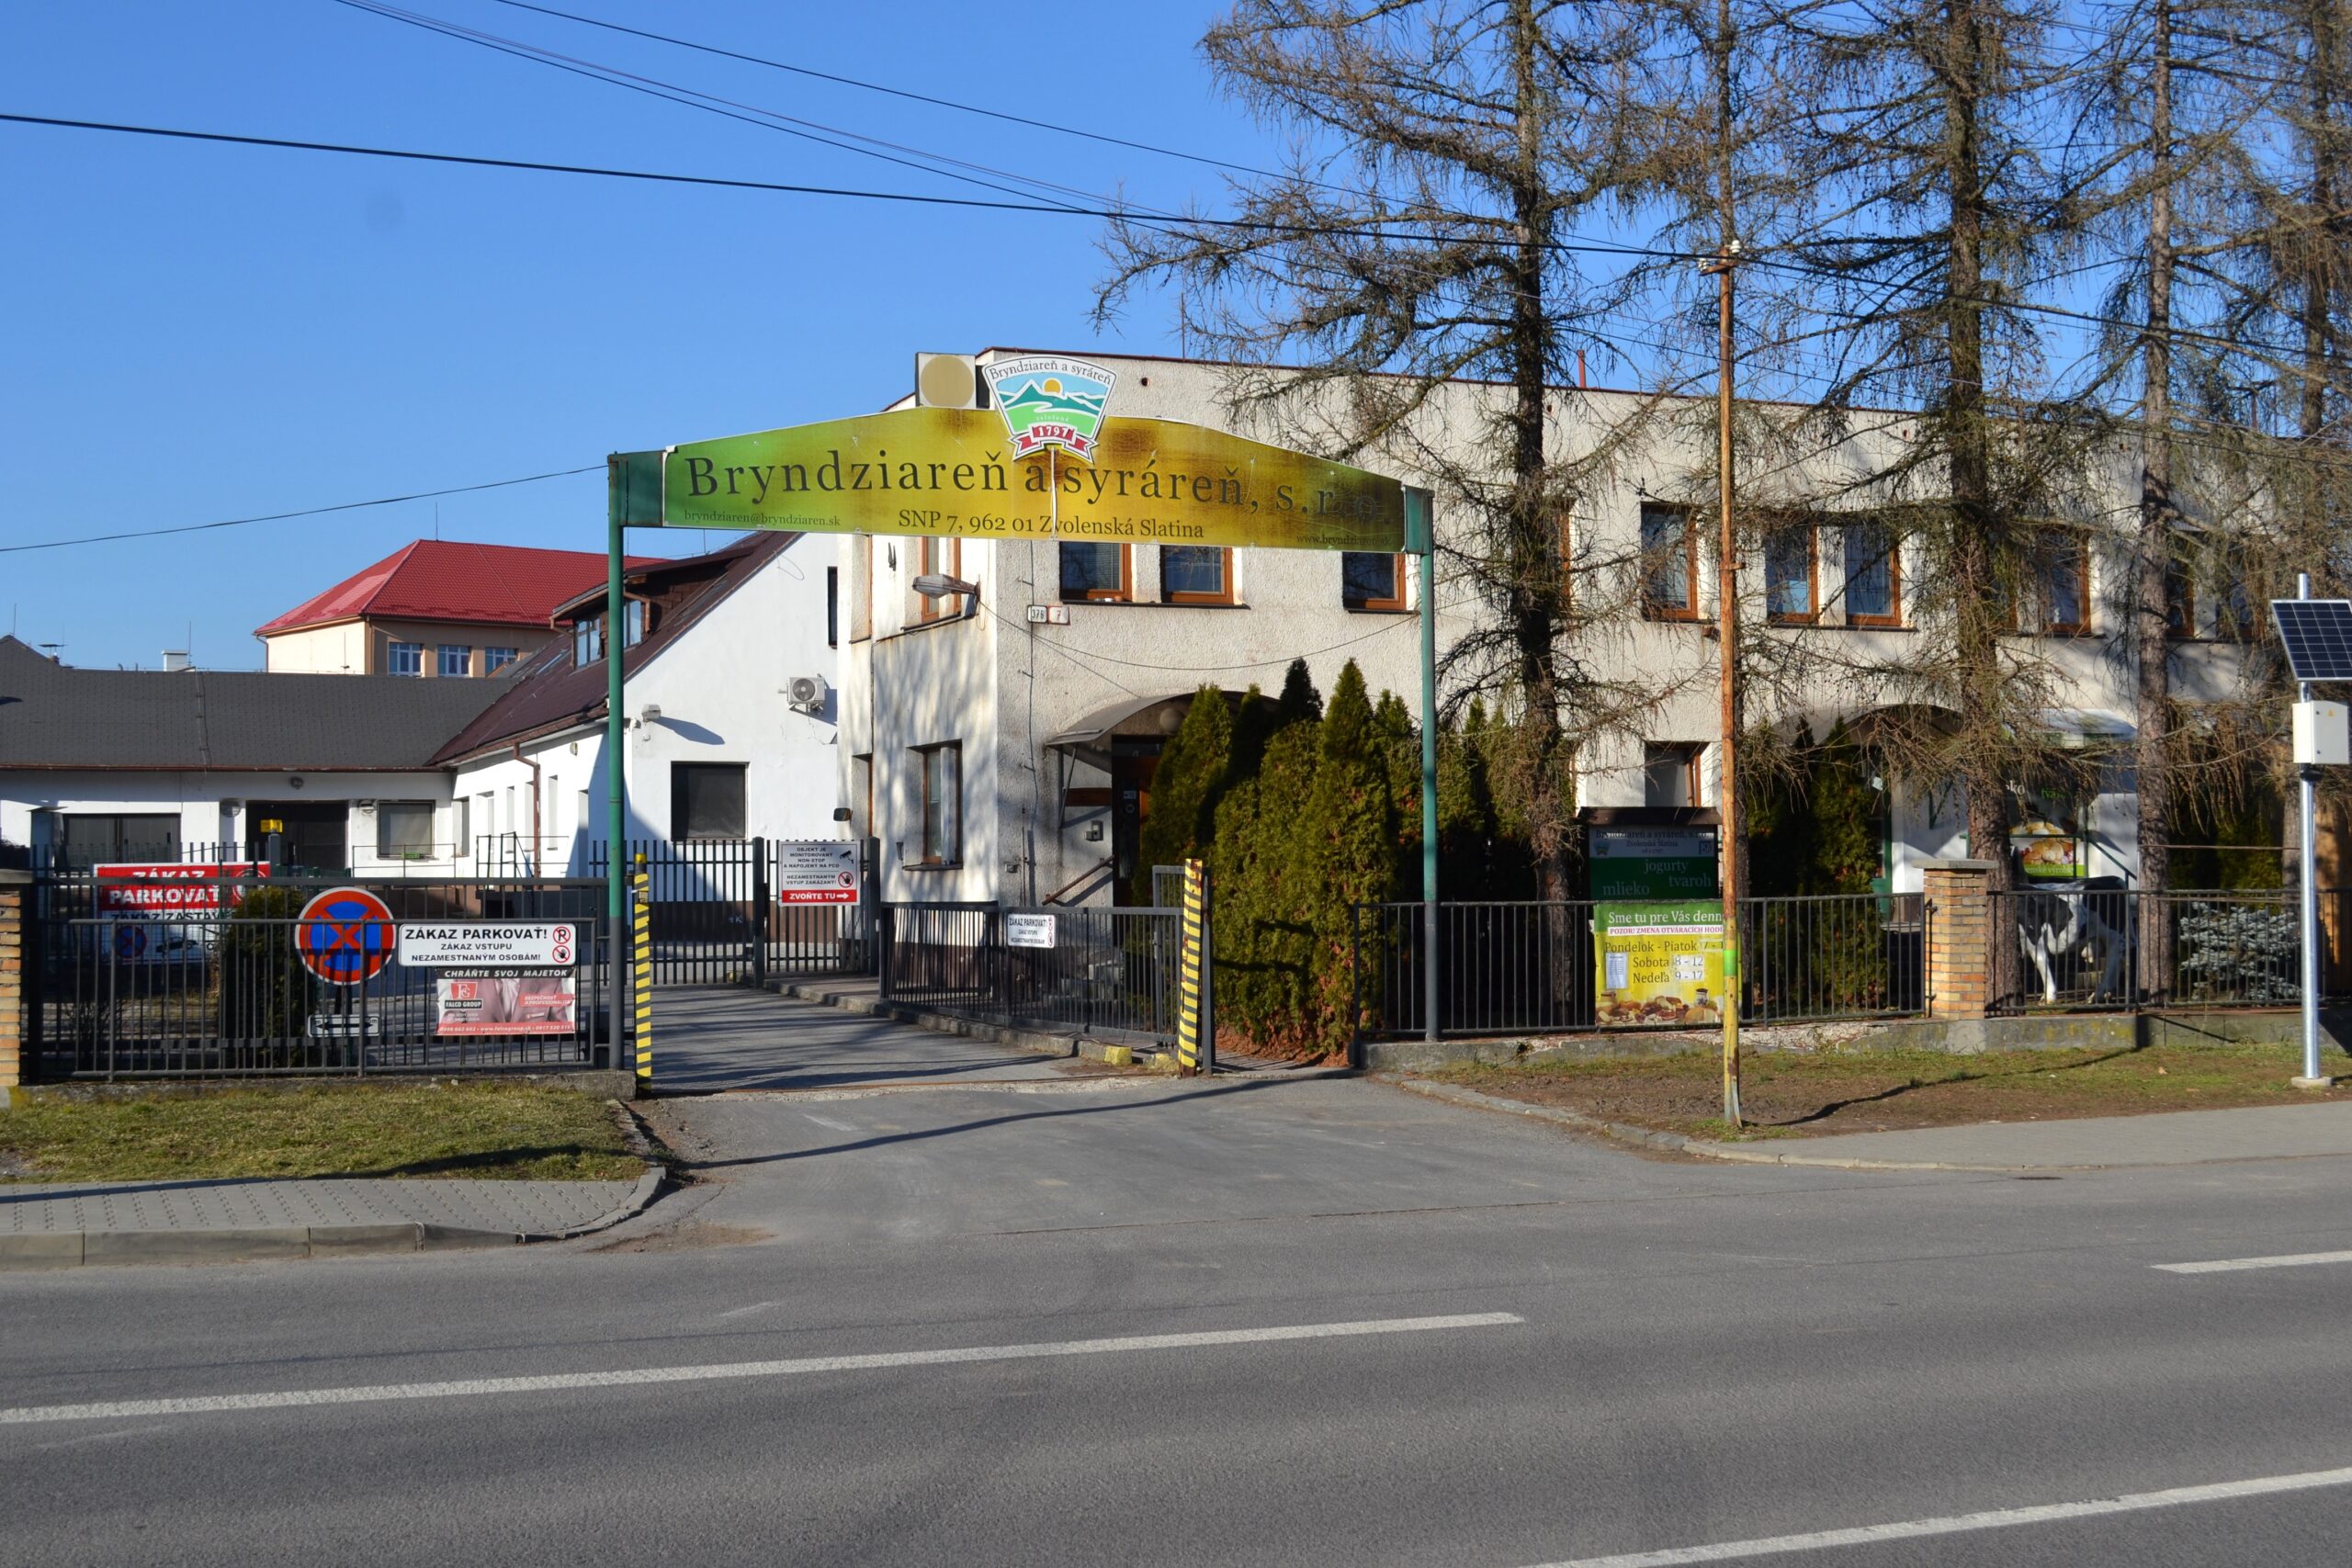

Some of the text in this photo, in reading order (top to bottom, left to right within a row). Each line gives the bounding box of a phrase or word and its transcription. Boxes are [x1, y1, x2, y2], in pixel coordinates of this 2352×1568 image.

[989, 360, 1112, 385] Bryndziareň a syráreň
[1037, 426, 1069, 438] 1797
[684, 450, 1009, 504] Bryndziareň
[1025, 462, 1046, 493] a
[1063, 459, 1259, 515] syráreň,
[684, 509, 841, 526] bryndziaren@bryndziaren.sk
[899, 510, 1204, 538] SNP 7, 962 01 Zvolenská Slatina
[1032, 608, 1045, 619] 376
[1057, 610, 1061, 620] 7
[1644, 859, 1690, 874] jogurty
[1668, 873, 1712, 887] tvaroh
[108, 886, 220, 904] PARKOVAŤ
[789, 891, 822, 899] ZVOŇTE
[1602, 881, 1650, 896] mlieko
[1609, 909, 1723, 926] Sme tu pre Vás denn
[405, 926, 548, 940] ZÁKAZ PARKOVAŤ!
[440, 942, 472, 951] ZÁKAZ
[1605, 942, 1654, 953] Pondelok
[1664, 941, 1697, 952] Piatok
[412, 953, 541, 962] NEZAMESTNANÝM OSOBÁM!
[1633, 957, 1669, 968] Sobota
[1675, 956, 1681, 965] 8
[1692, 955, 1703, 965] 12
[445, 968, 568, 977] CHRÁŇTE SVOJ MAJETOK
[1633, 972, 1669, 983] Nedeľa
[1675, 972, 1680, 980] 9
[1692, 971, 1702, 980] 17
